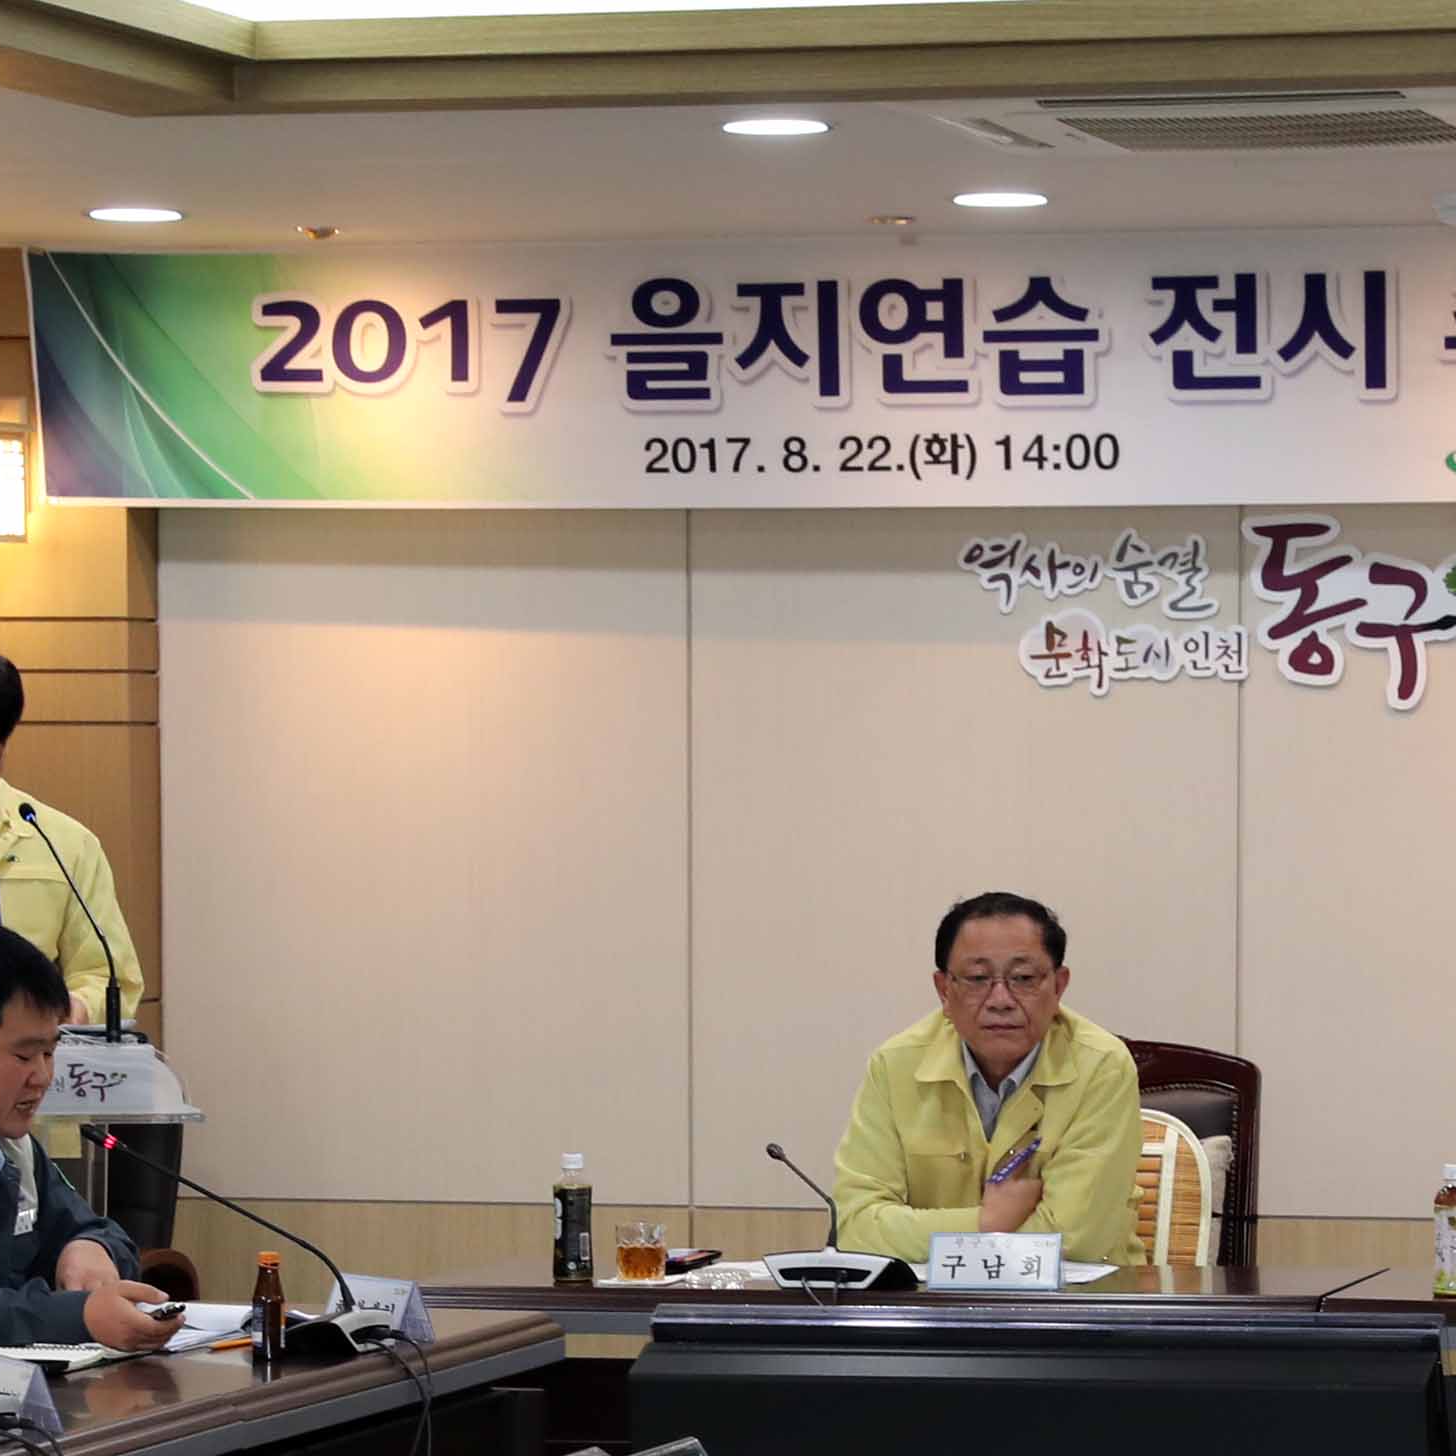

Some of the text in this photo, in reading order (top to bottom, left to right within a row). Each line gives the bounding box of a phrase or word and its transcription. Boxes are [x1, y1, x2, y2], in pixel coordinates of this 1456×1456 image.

[258, 298, 561, 404] 2017
[610, 277, 1100, 400] 을지연습
[1150, 270, 1387, 395] 전시
[645, 431, 1120, 479] 2017. 8. 22.(화) 14:00
[963, 535, 1213, 613] 역사의 숨결
[1252, 522, 1428, 700] 동구
[1029, 621, 1244, 690] 문화도시 인천
[67, 1063, 113, 1102] 동구
[941, 1253, 1042, 1280] 구남회
